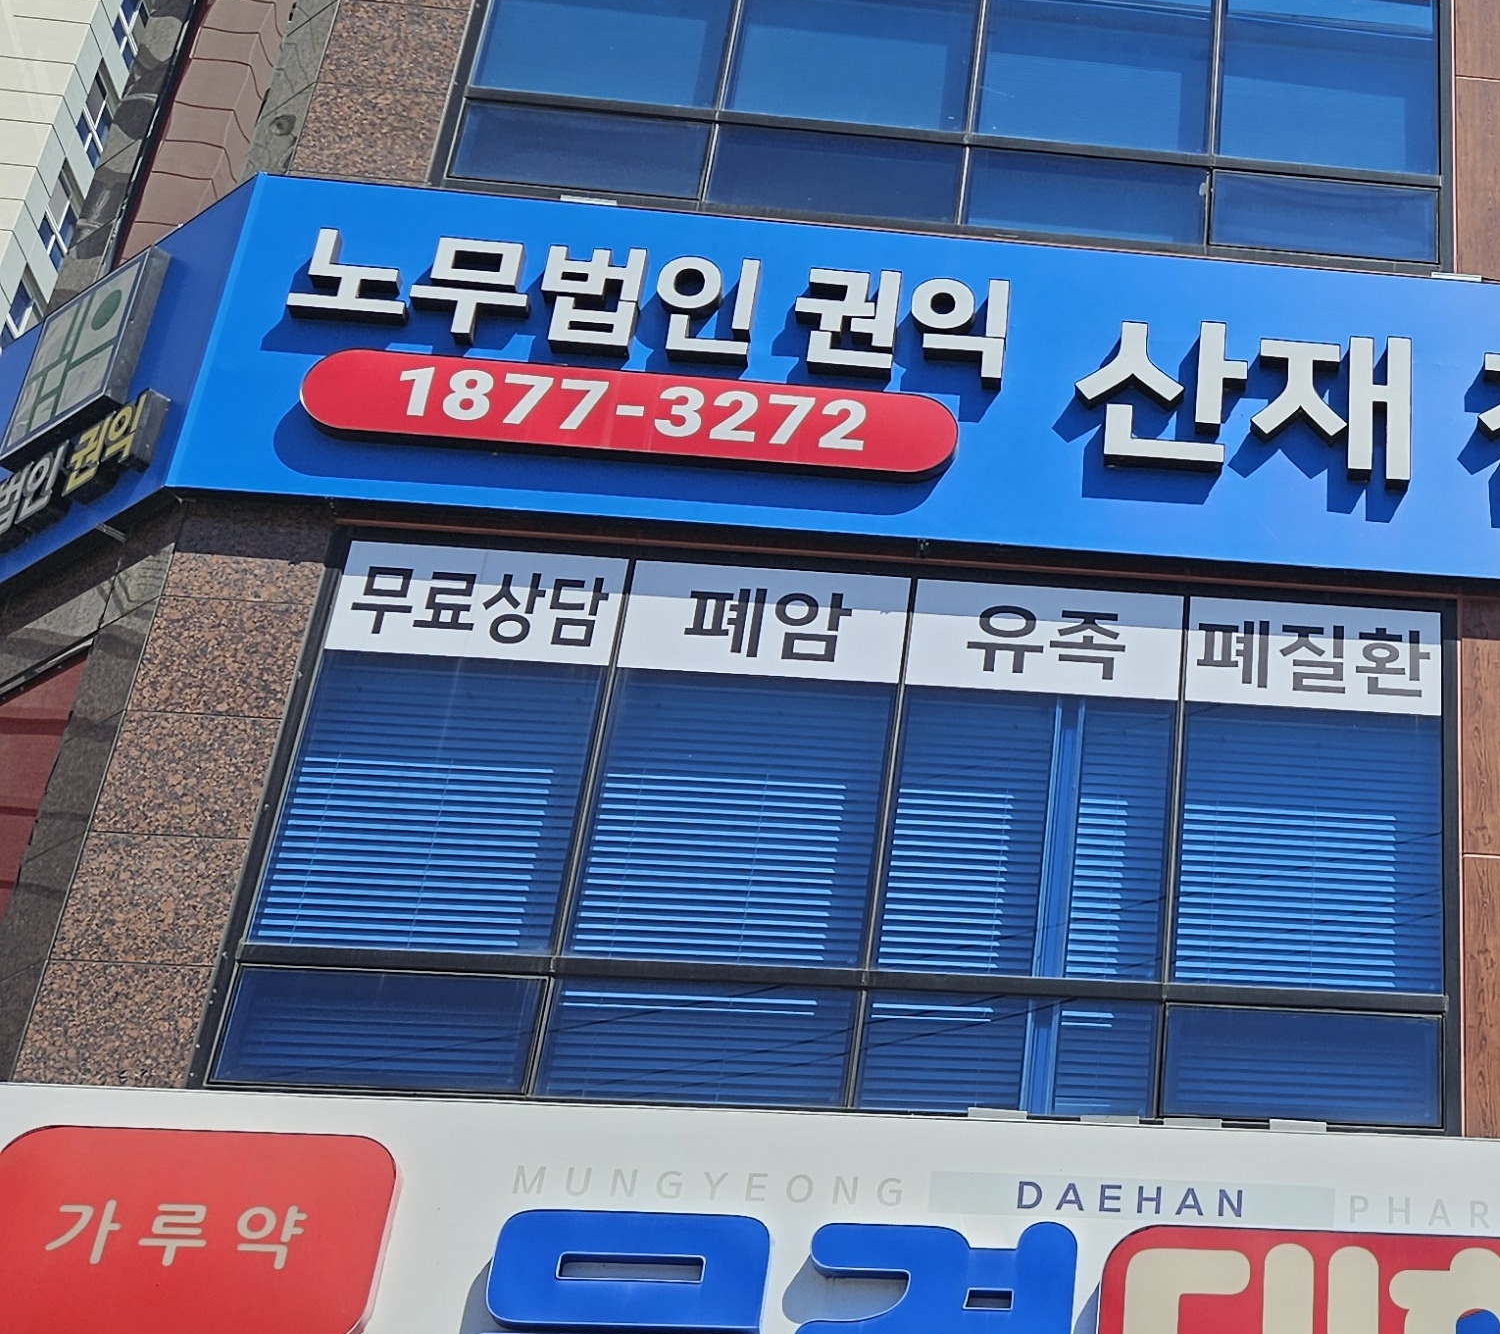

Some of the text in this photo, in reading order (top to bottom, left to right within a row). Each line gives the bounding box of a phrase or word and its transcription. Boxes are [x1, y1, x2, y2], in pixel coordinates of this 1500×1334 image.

[285, 227, 762, 369] 노무법인
[795, 269, 1011, 391] 권익
[1074, 319, 1413, 494] 산재
[399, 366, 869, 452] 1877-3272
[351, 564, 610, 649] 무료상담
[684, 585, 853, 663] 폐암
[965, 603, 1127, 681] 유족
[1197, 617, 1430, 699] 폐질환
[512, 1163, 906, 1207] MUNGYEONG
[1016, 1180, 1245, 1218] DAEHAN
